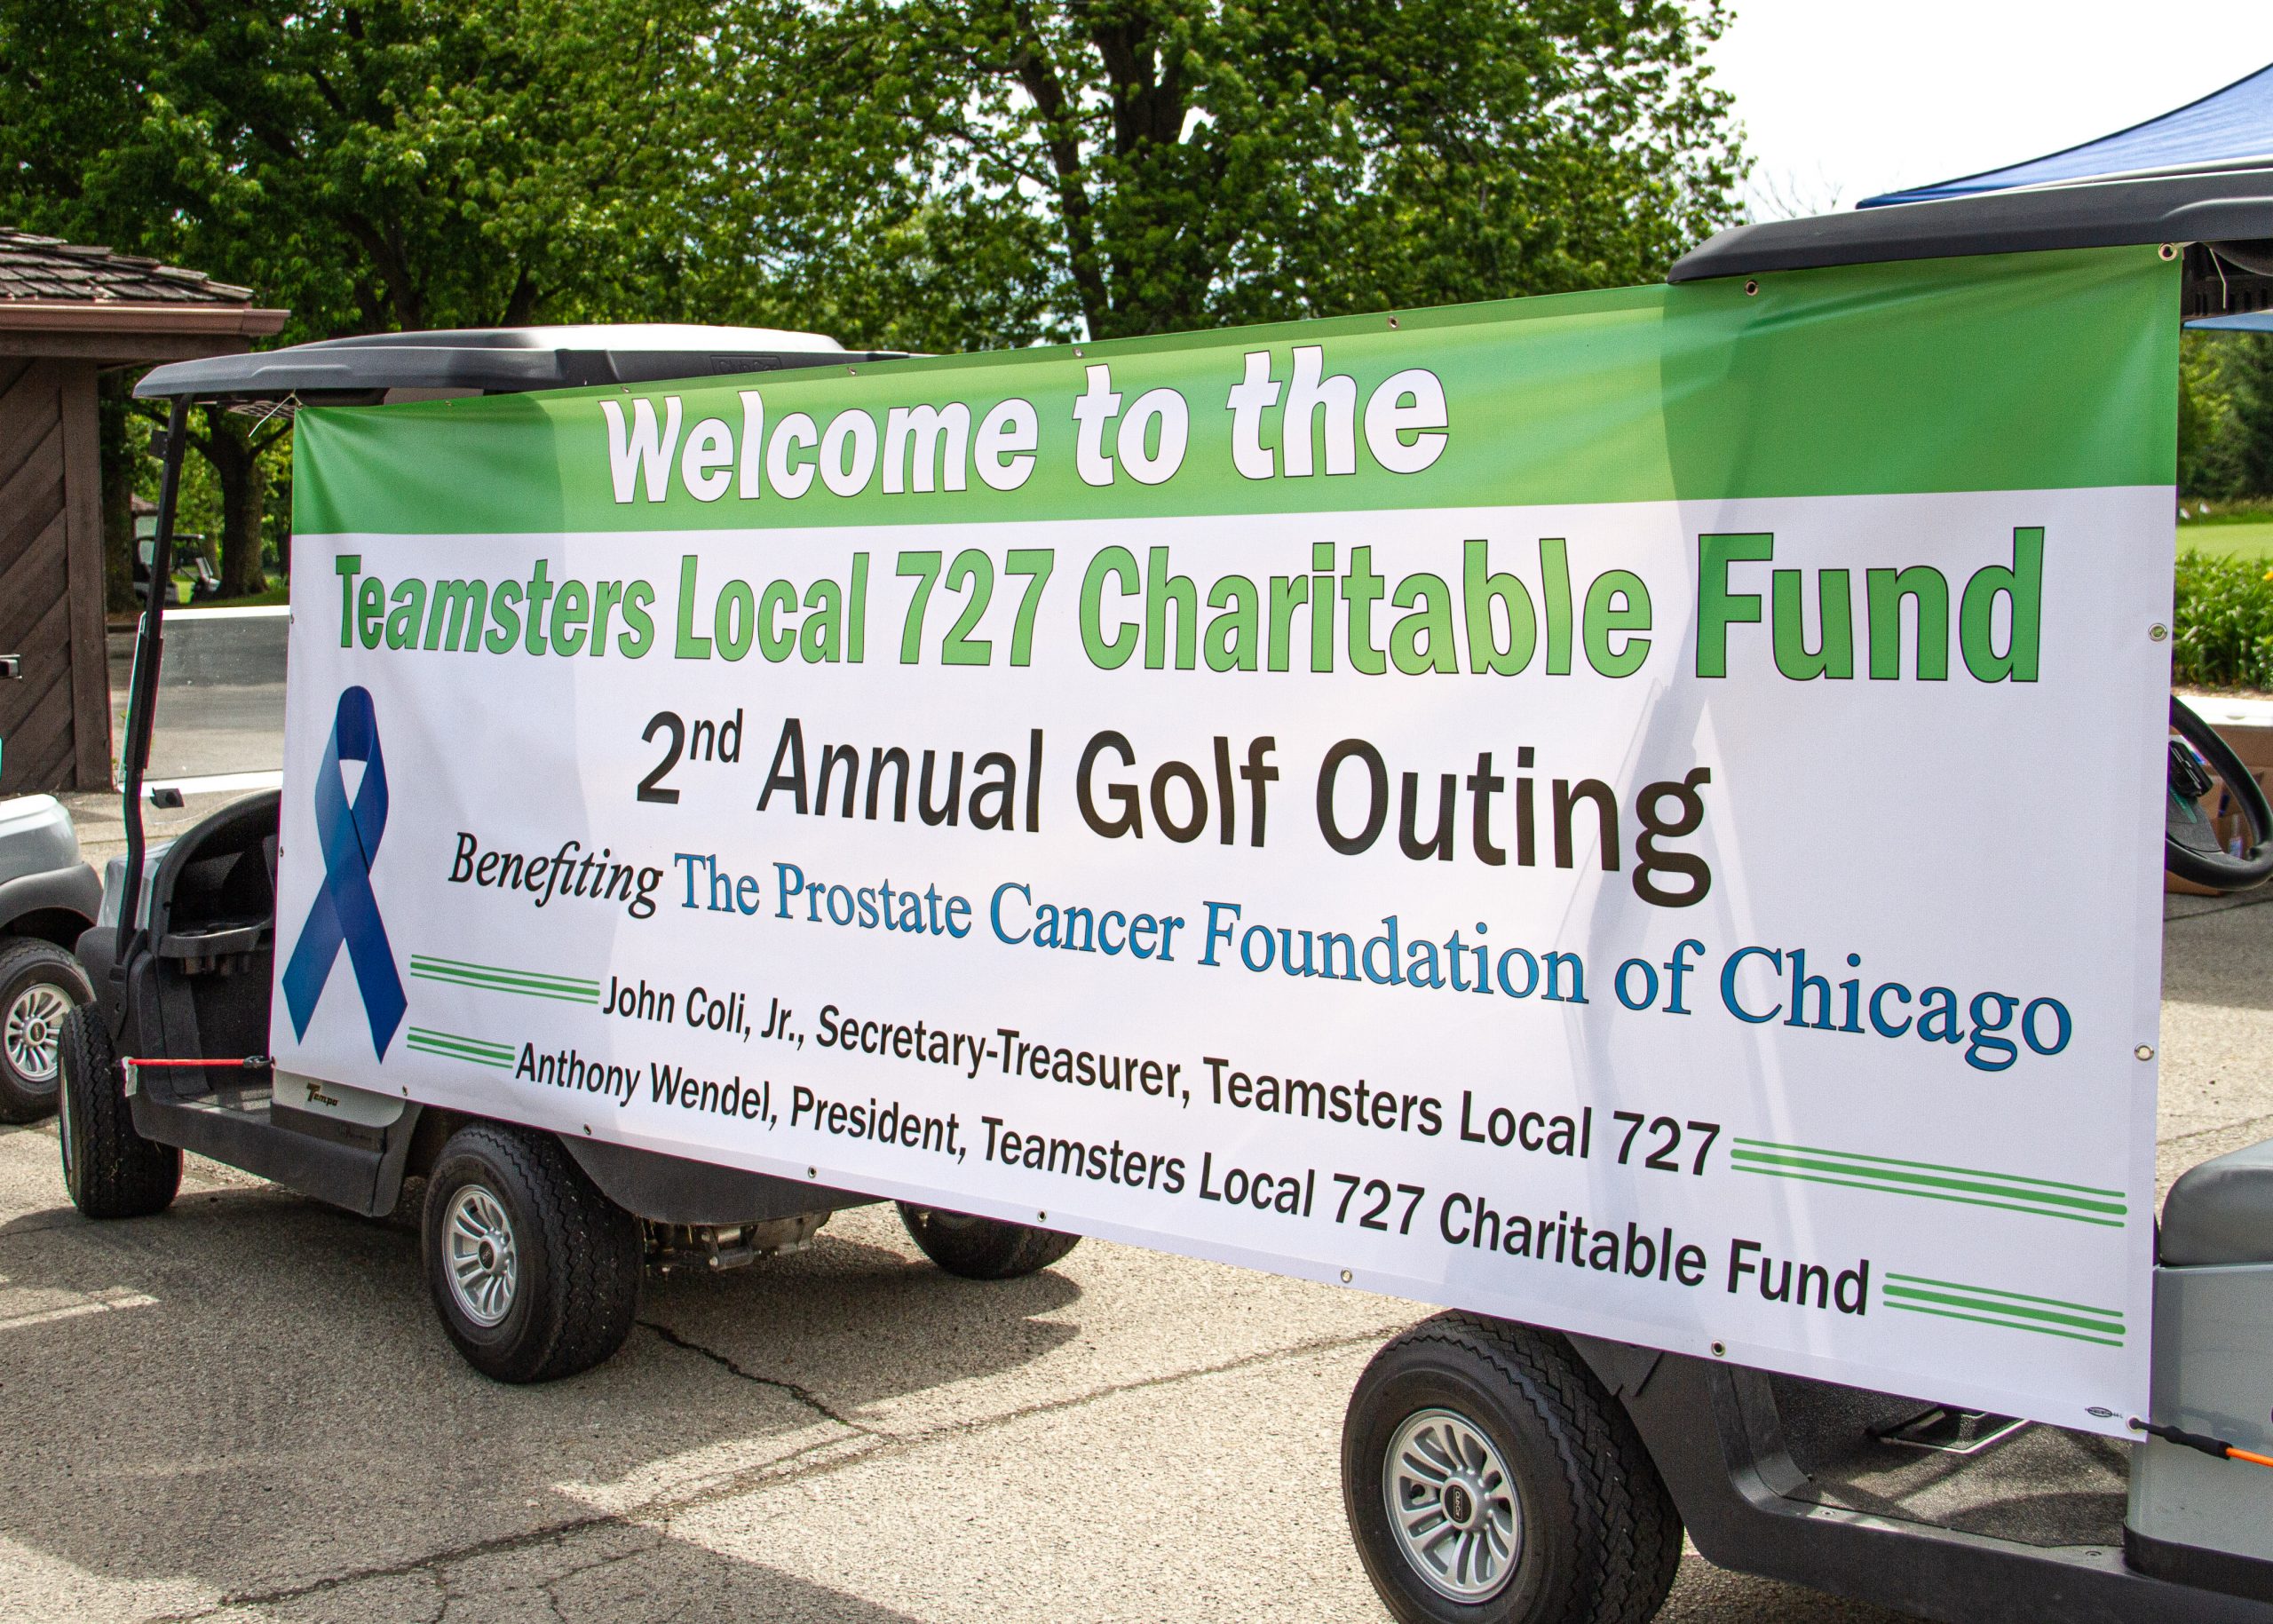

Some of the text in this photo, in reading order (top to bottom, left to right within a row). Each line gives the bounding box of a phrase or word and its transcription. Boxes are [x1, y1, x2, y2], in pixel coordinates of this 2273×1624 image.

[598, 345, 1449, 504] Welcome to the
[336, 527, 2045, 683] Teamsters Local 727 Charitable Fund
[638, 709, 1711, 907] 2nd Annual Golf Outing
[447, 832, 2071, 1072] Benefiting The Prostate Cancer Foundation of Chicago
[306, 1082, 339, 1107] Tempo
[603, 977, 1720, 1176] John Coli, Jr., Secretary-Treasurer, Teamsters Local 727
[515, 1042, 1869, 1315] Anthony Wendel, President, Teamsters Local 727 Charitable Fund
